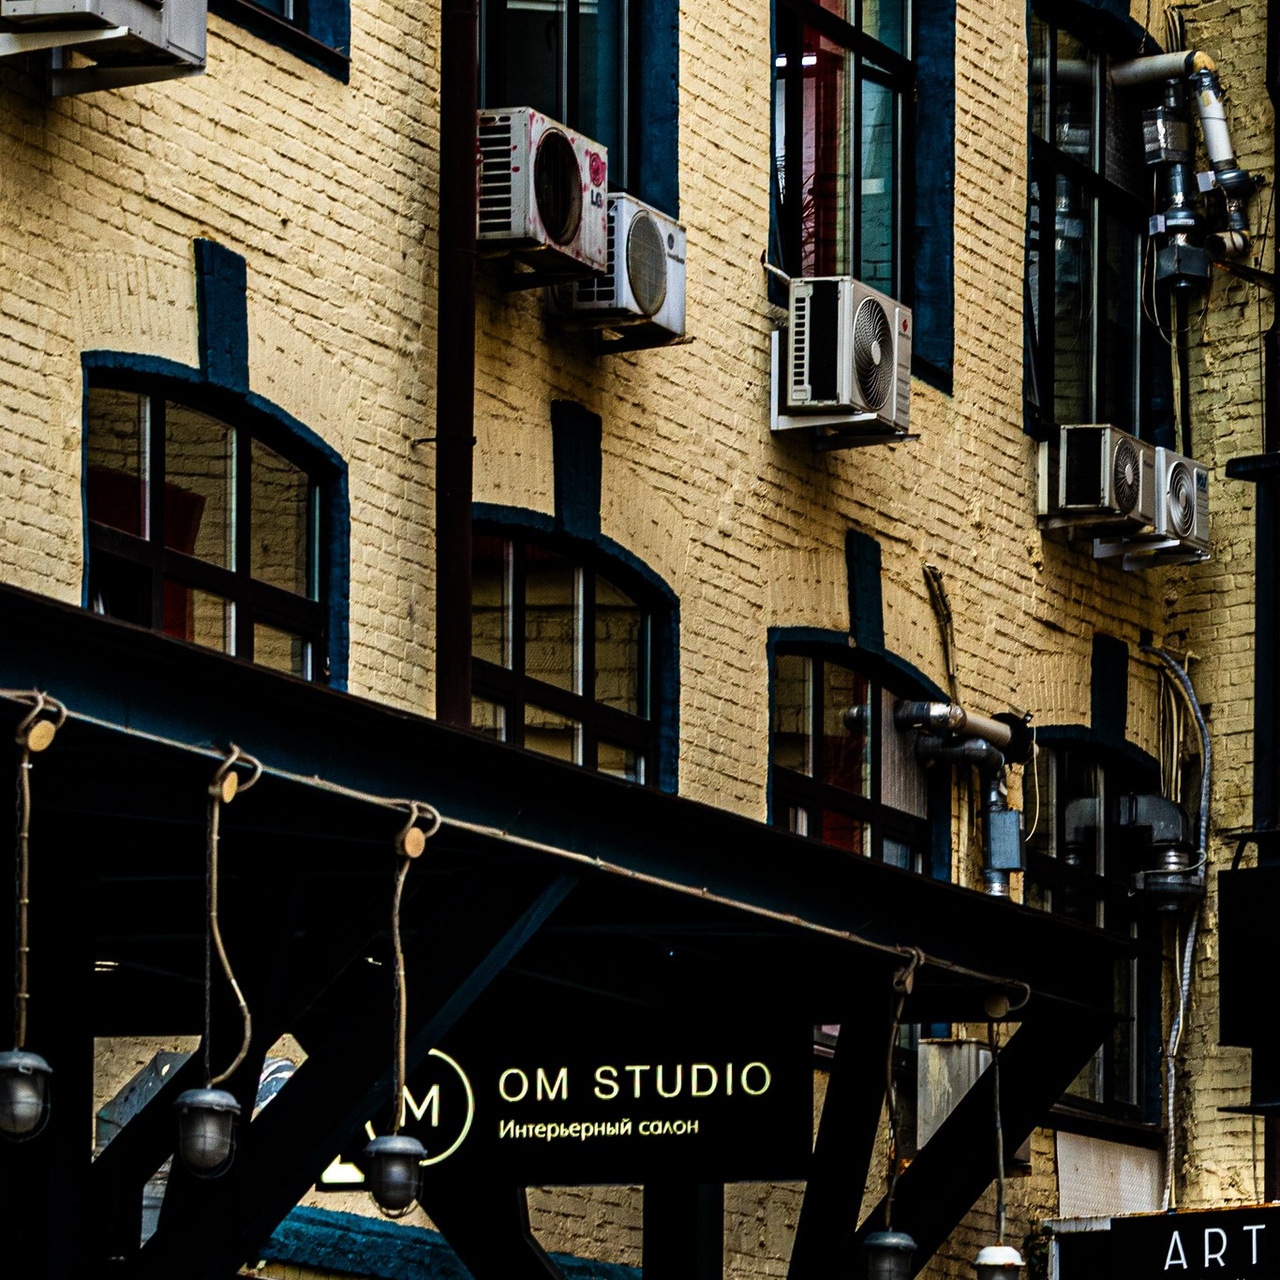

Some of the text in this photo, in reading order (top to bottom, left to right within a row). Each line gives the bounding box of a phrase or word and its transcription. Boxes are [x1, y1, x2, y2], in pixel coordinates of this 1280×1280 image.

[590, 189, 603, 208] LG
[497, 1060, 773, 1104] OM STUDIO
[497, 1116, 700, 1142] Интерьерный салон
